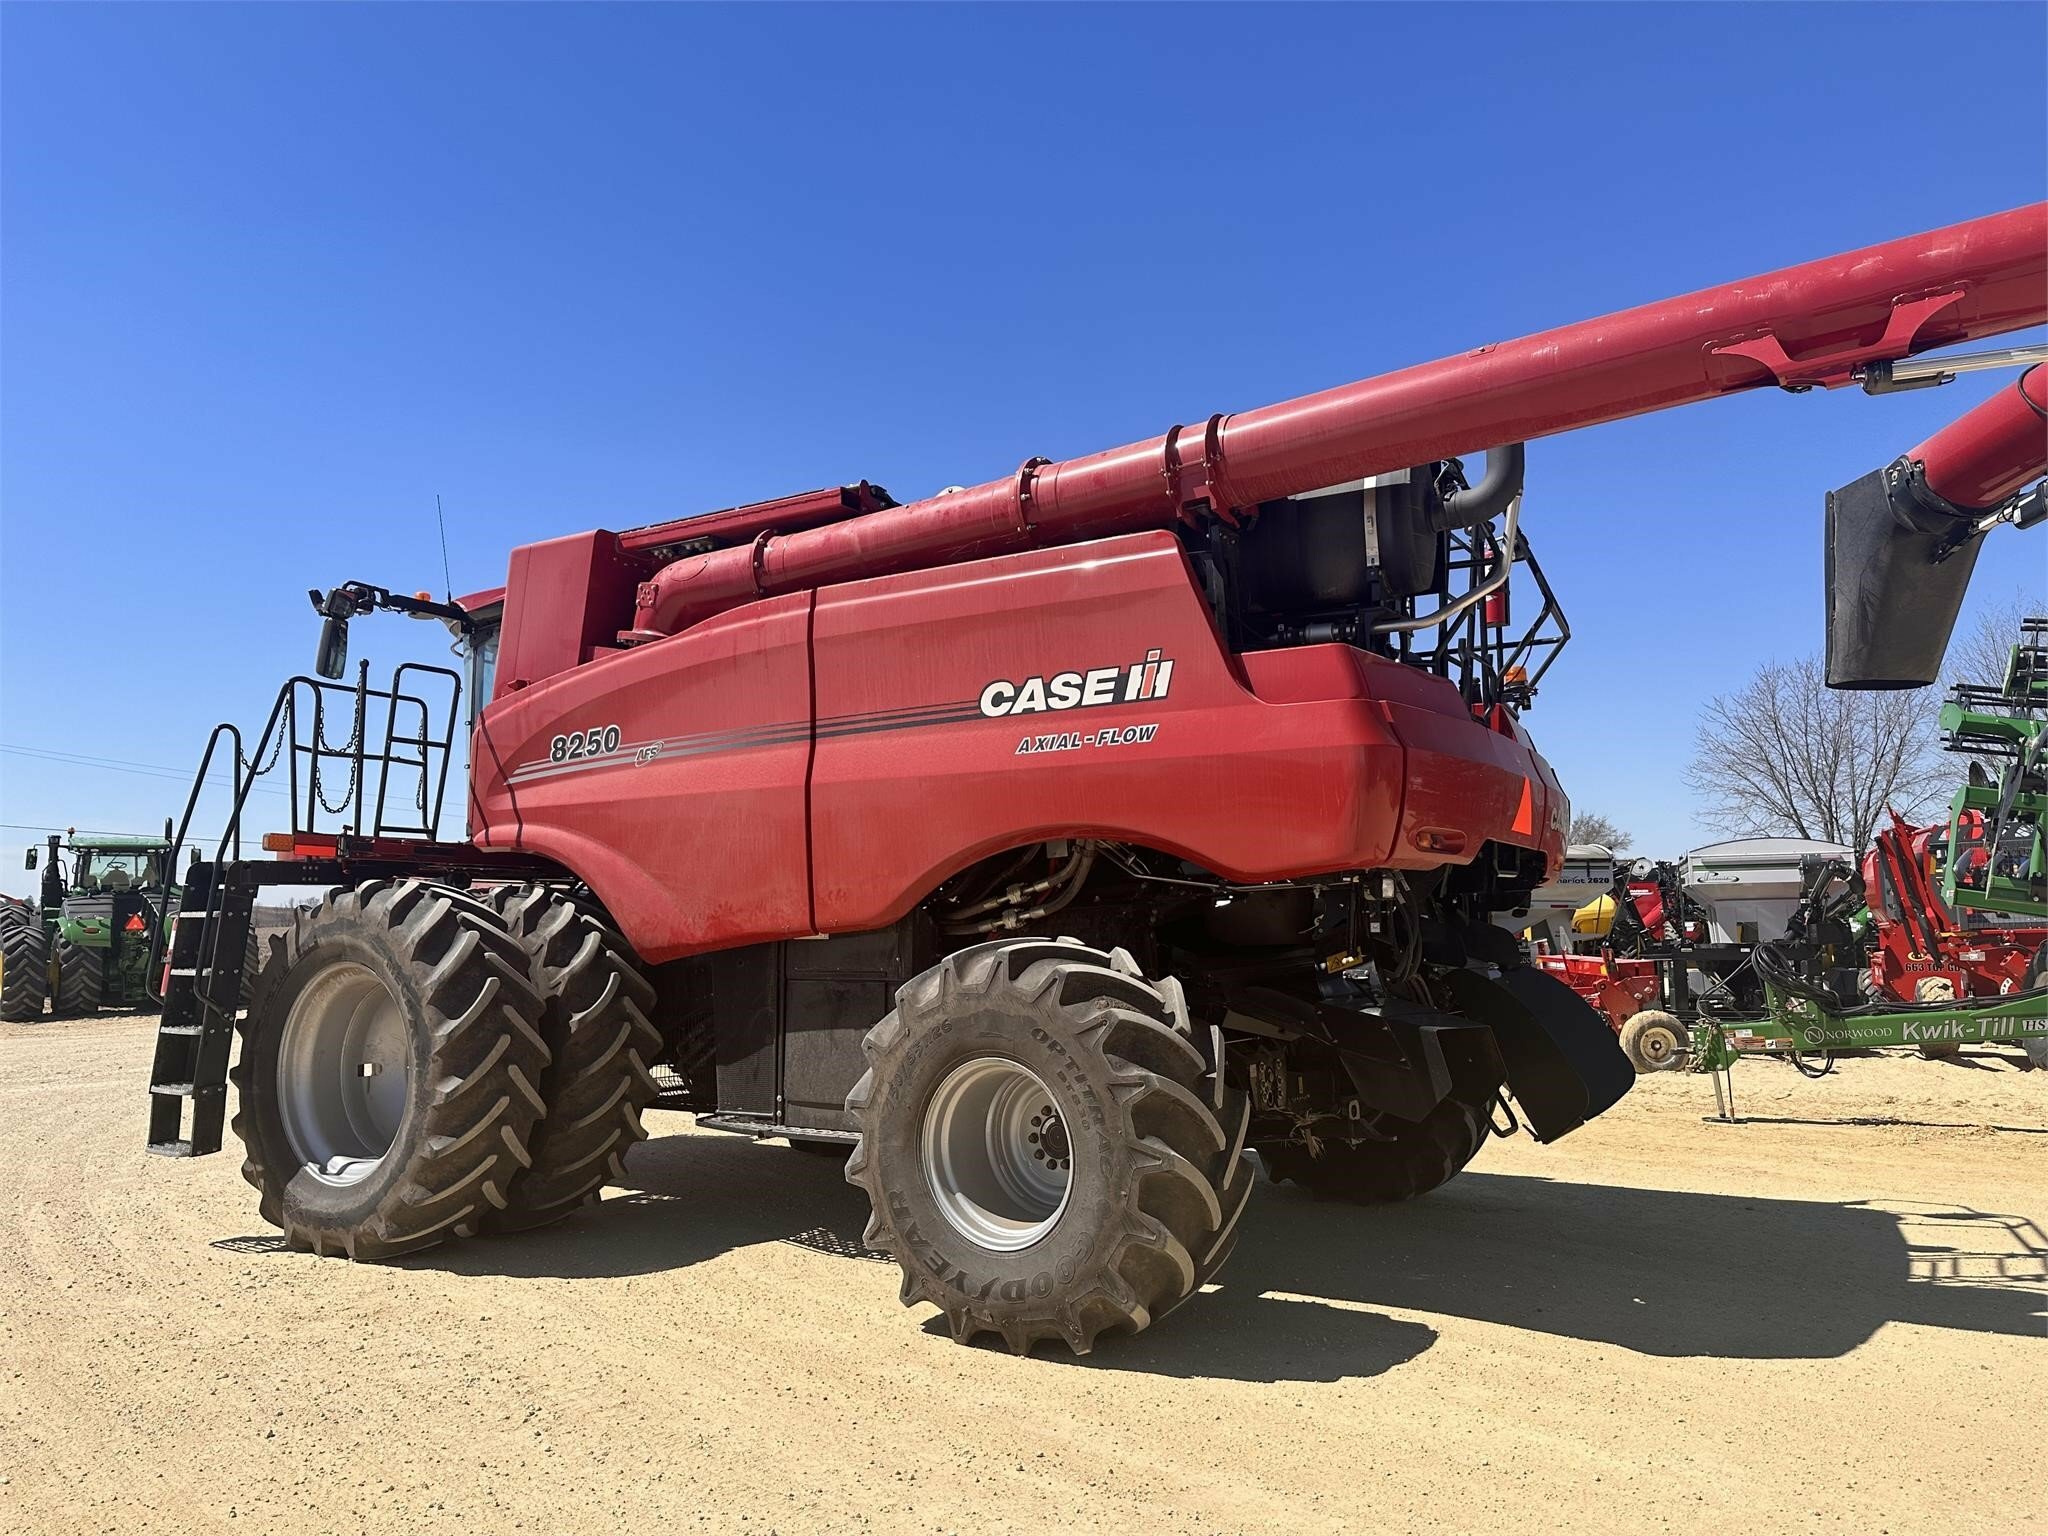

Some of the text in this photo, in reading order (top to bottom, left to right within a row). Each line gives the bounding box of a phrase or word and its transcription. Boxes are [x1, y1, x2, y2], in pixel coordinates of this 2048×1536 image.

[979, 667, 1121, 717] CASE
[550, 724, 621, 764] 8250
[635, 745, 659, 761] AFS
[1015, 723, 1159, 755] AXIAL-FLOW
[1905, 963, 1925, 972] 663
[1825, 1027, 1893, 1040] NORWOOD
[1902, 1016, 2015, 1041] Kwik-Till
[1030, 1027, 1114, 1179] OPTITRAC
[888, 1190, 1095, 1303] GOODYEAR
